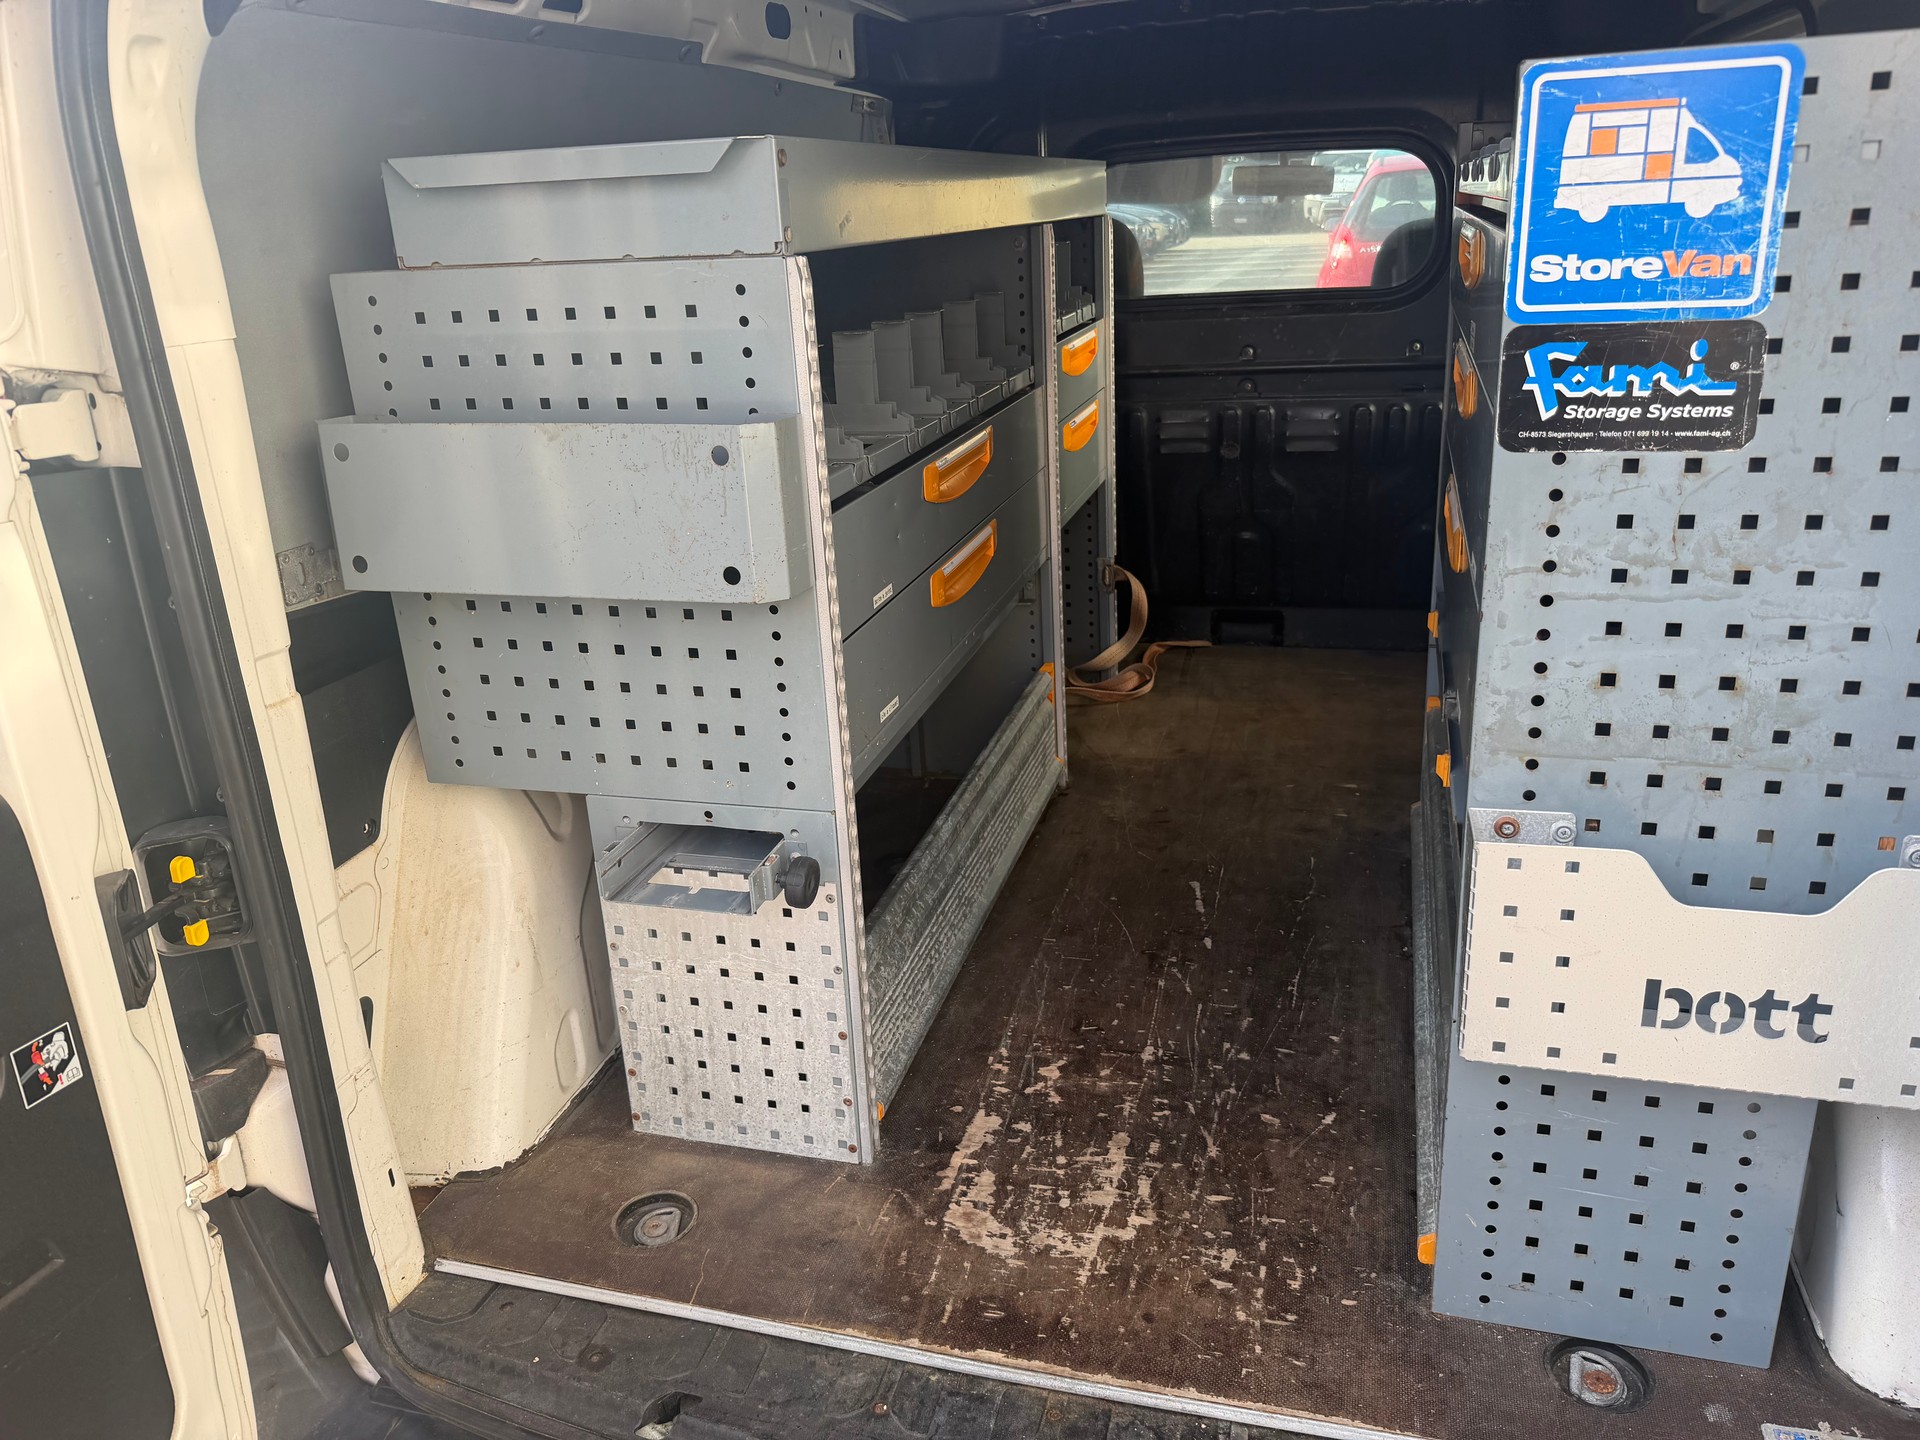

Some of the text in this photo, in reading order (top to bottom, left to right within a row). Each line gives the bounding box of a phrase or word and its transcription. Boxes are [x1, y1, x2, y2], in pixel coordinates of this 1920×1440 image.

[1529, 249, 1752, 282] StoreVan
[1521, 338, 1737, 421] Fami
[1563, 404, 1734, 421] Storage Systems
[1518, 430, 1546, 438] CH-8573
[1547, 430, 1594, 439] Siegershausen
[1599, 430, 1622, 438] Telefon
[1674, 430, 1731, 438] www.fami-ag.ch
[1641, 978, 1834, 1043] bott
